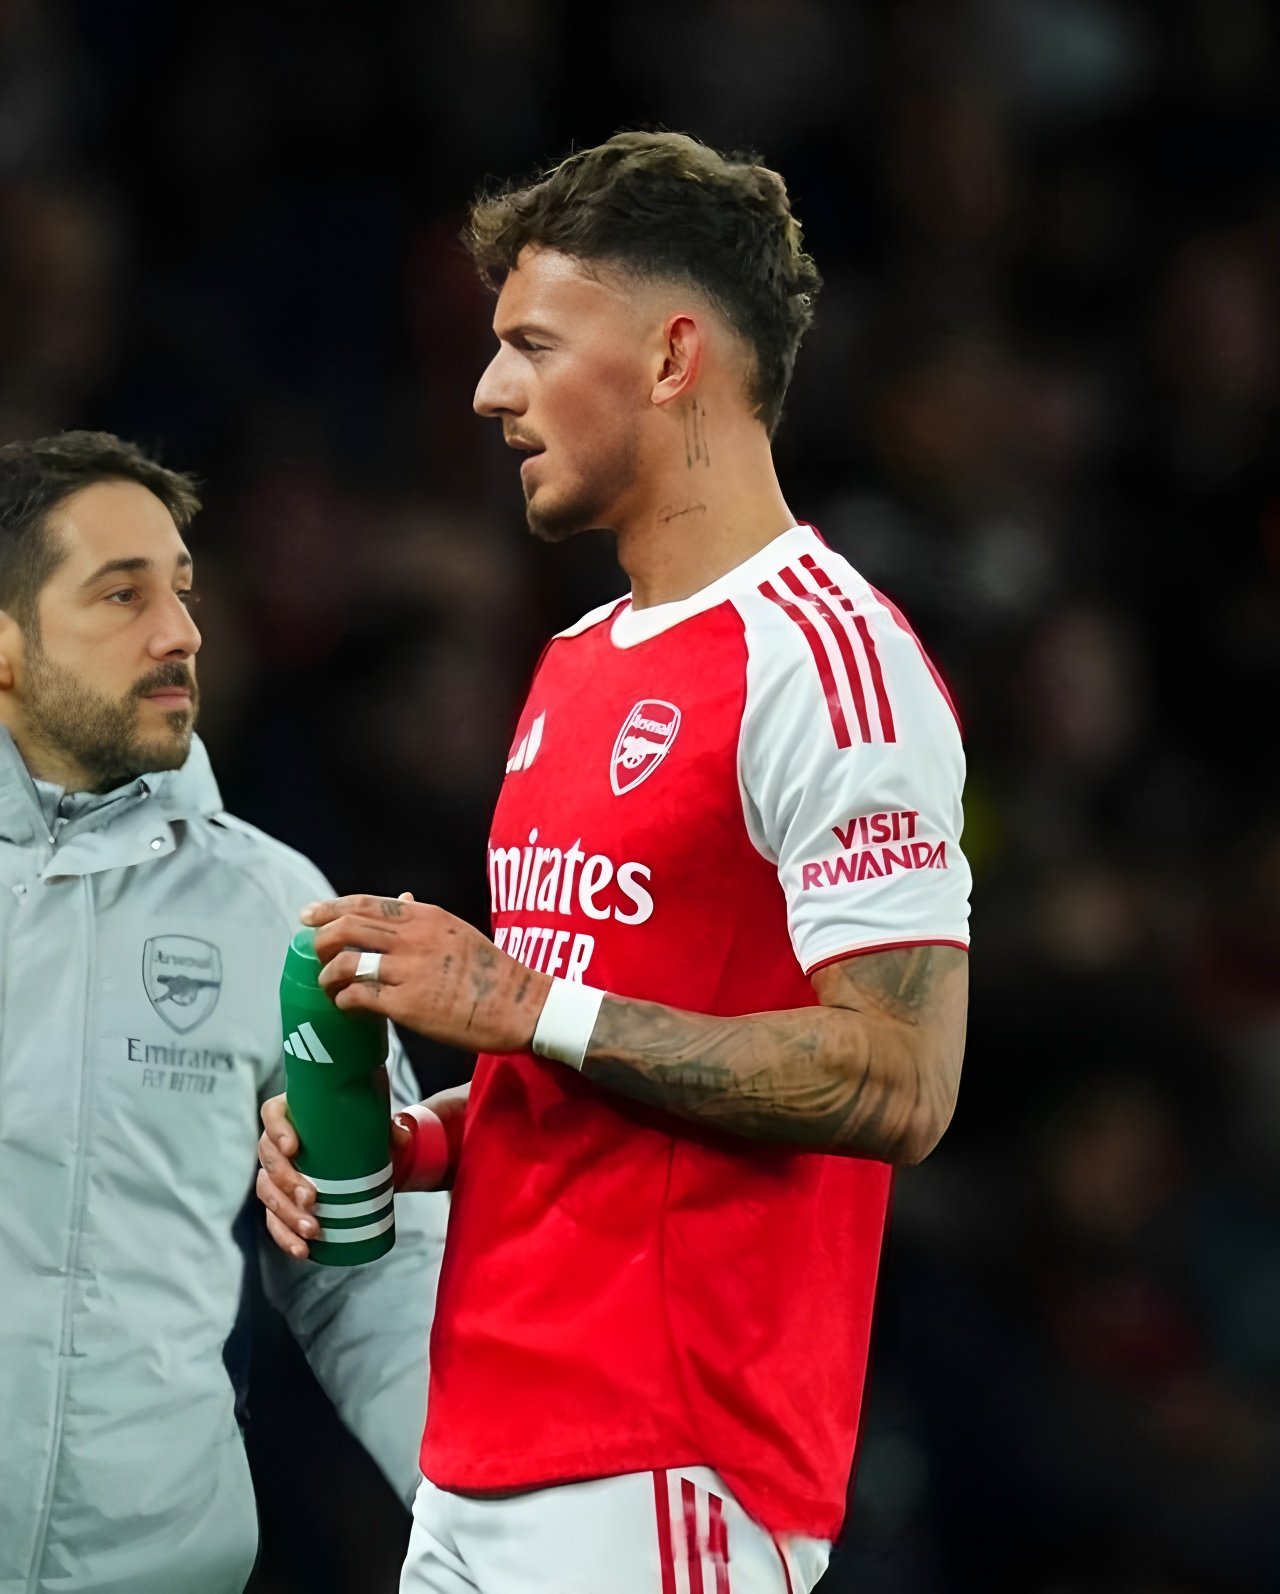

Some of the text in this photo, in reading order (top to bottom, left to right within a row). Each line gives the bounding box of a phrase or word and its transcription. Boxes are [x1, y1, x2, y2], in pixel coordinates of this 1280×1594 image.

[831, 811, 919, 850] VISIT
[488, 827, 654, 925] mirates
[802, 841, 948, 891] RWANDA
[127, 1037, 234, 1073] Emirates
